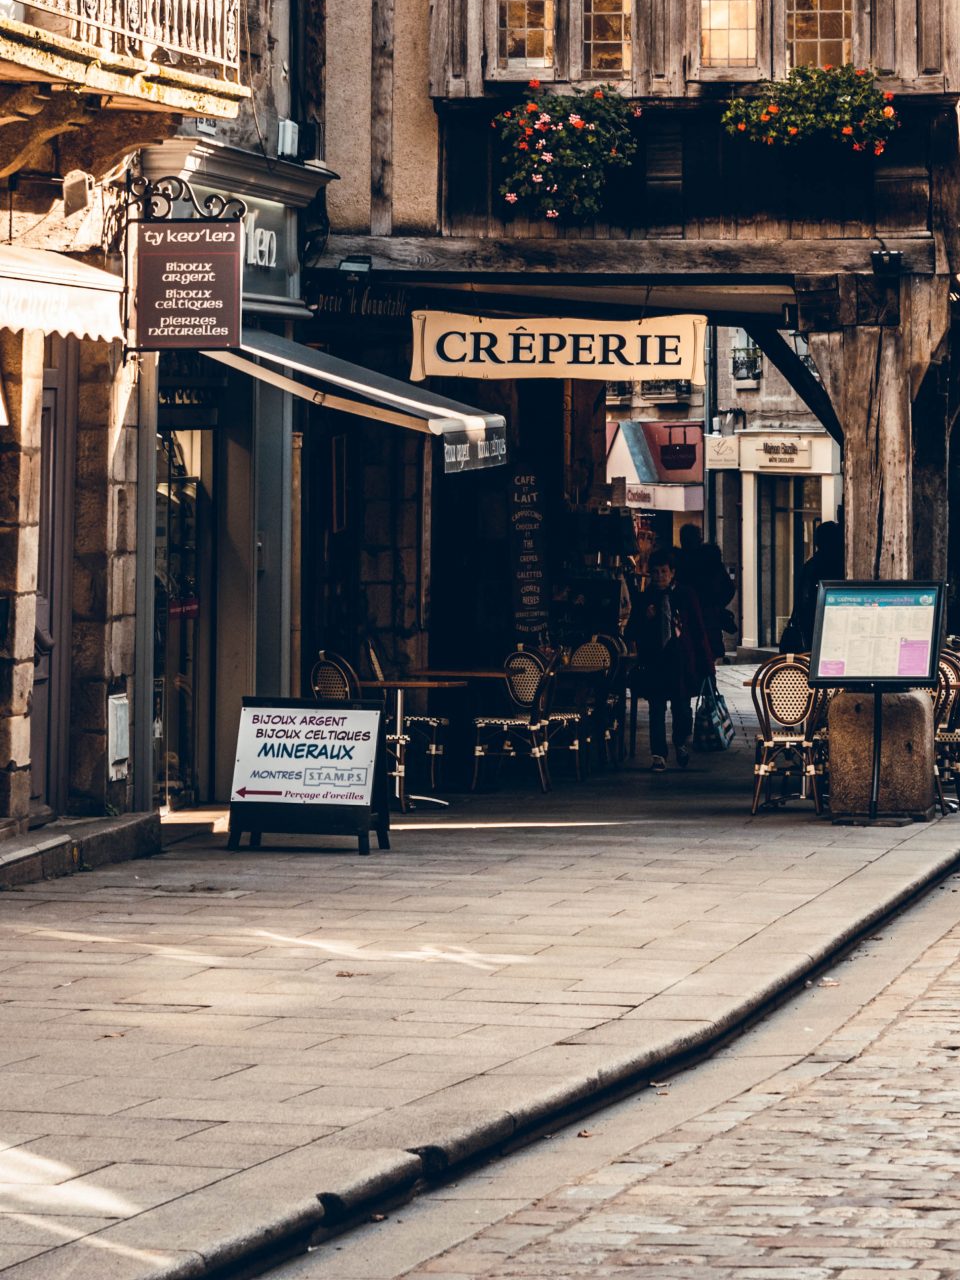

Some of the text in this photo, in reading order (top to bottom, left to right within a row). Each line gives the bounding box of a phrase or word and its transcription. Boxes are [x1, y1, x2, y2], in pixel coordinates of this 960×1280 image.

[436, 326, 682, 365] CRÊPERIE
[252, 714, 348, 726] BIJOUX ARGENT
[256, 729, 371, 741] BIJOUX CELTIQUES
[257, 742, 355, 760] MINERAUX
[250, 770, 364, 782] MONTRES S.T.A.M.P.S.
[284, 790, 364, 801] Perçage d'oreilles
